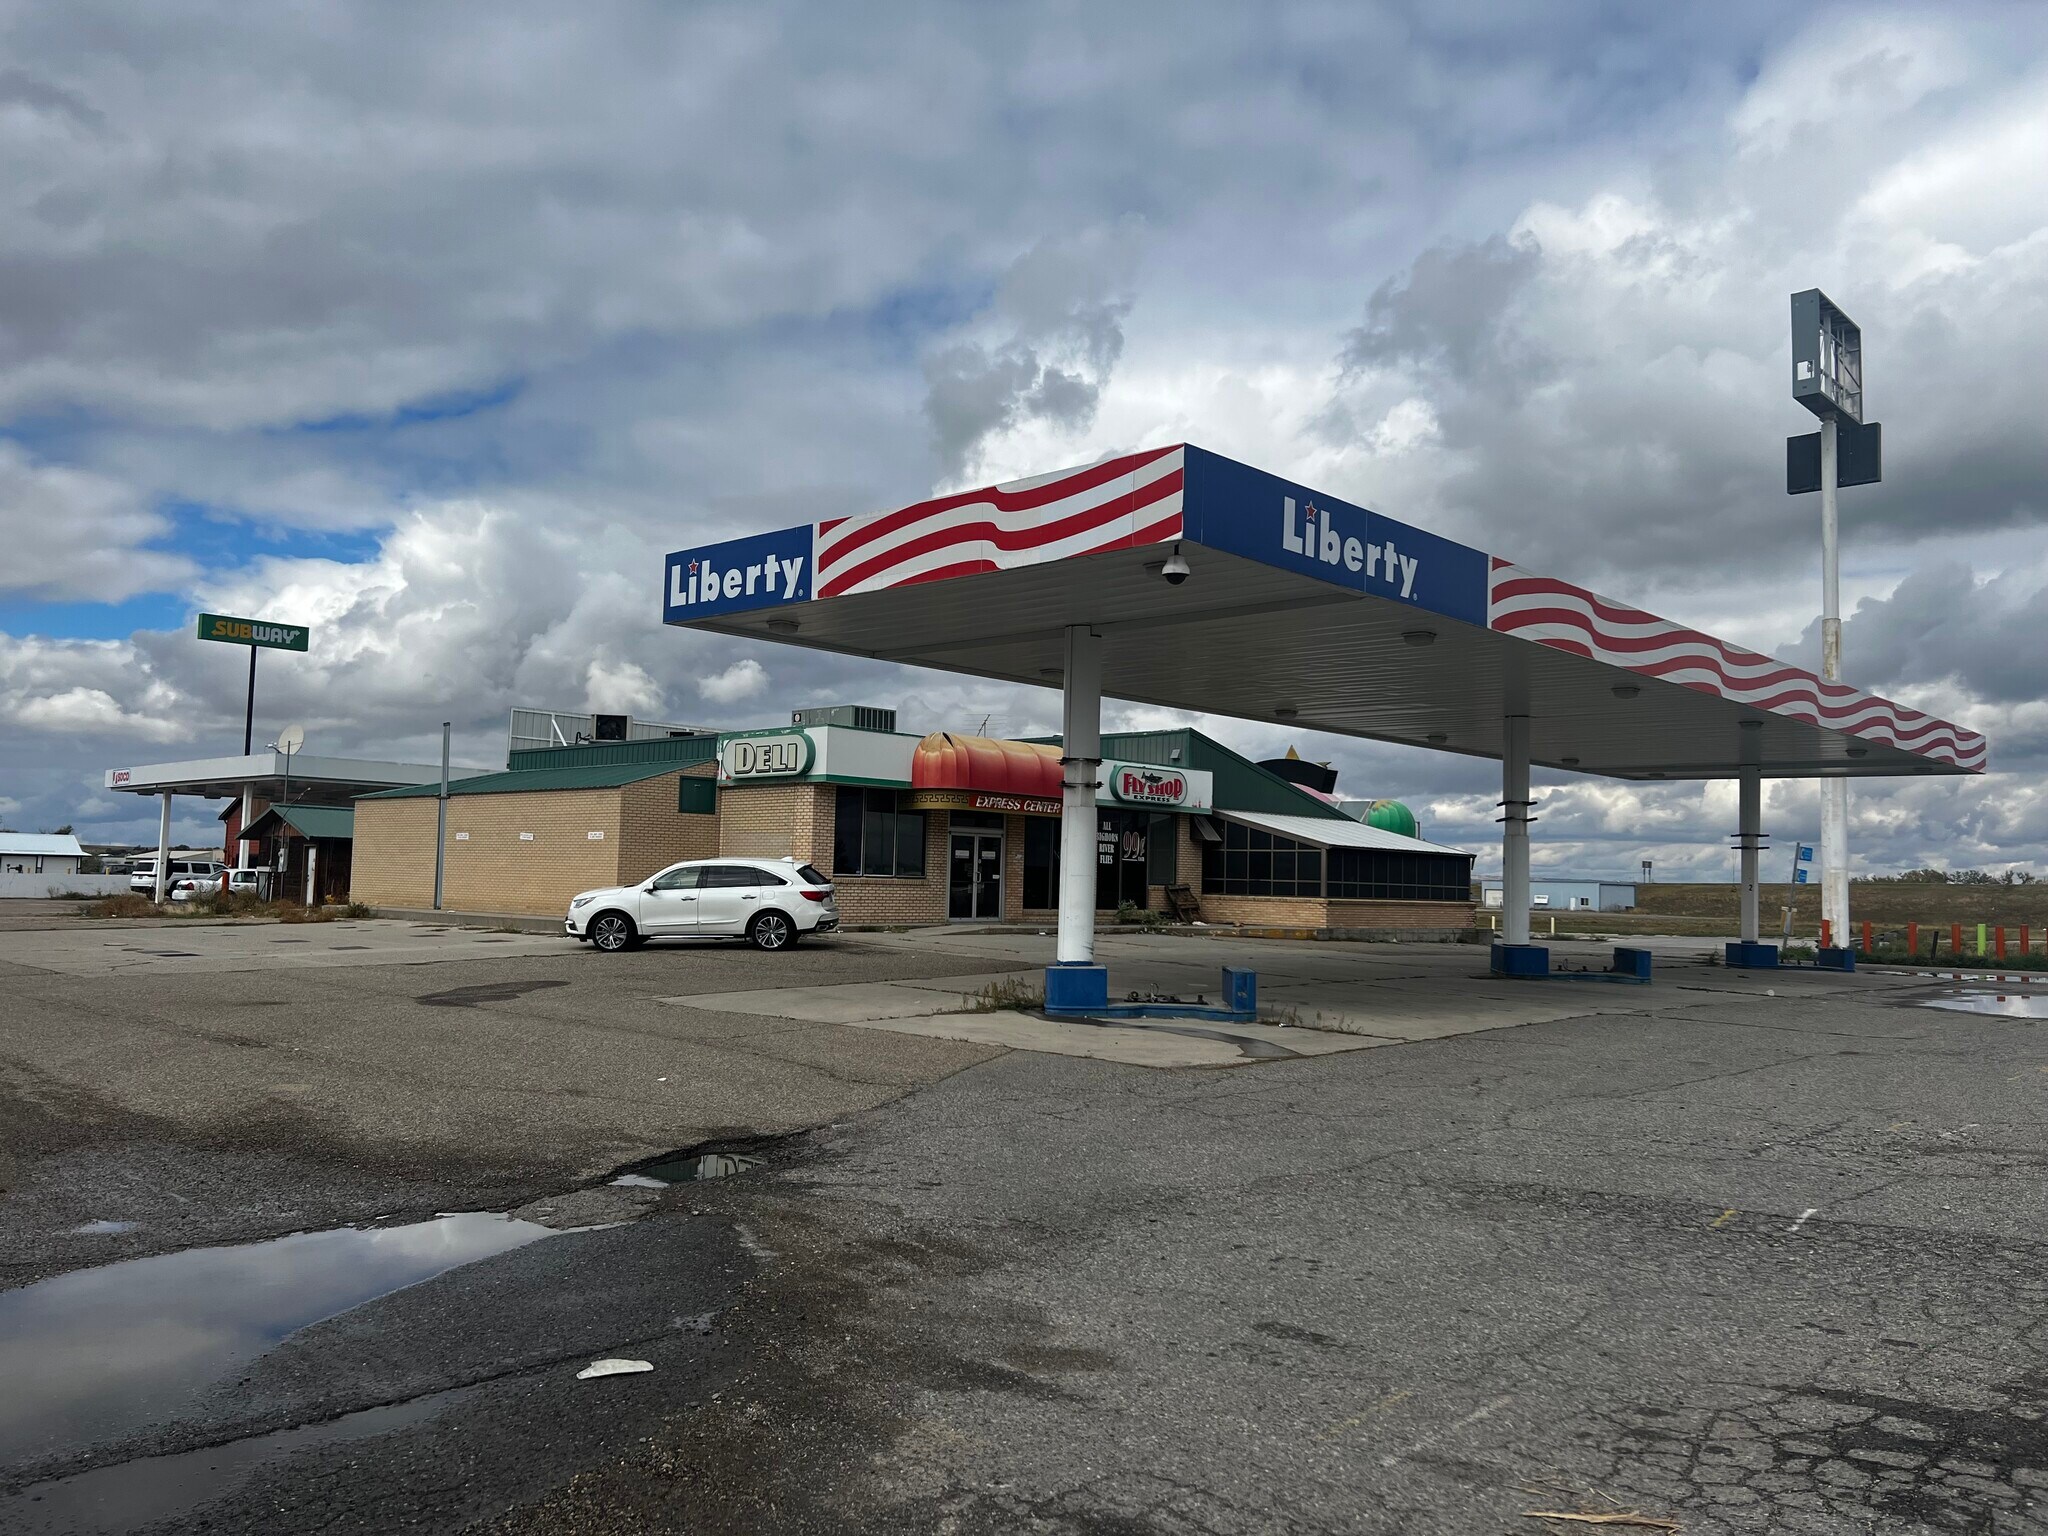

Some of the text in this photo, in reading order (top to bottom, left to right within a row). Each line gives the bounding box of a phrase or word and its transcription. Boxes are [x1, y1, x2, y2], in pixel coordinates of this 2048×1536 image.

[1282, 496, 1418, 599] Liberty
[669, 553, 804, 607] Liberty
[211, 621, 300, 644] SUBWAY
[734, 743, 797, 774] DELI
[1123, 773, 1183, 800] FLY SHOP
[976, 796, 1061, 813] EXPRESS CENTER
[1102, 821, 1112, 831] ALL
[1099, 843, 1115, 853] RIVER
[1100, 854, 1113, 864] FLIES
[1748, 884, 1753, 892] 2
